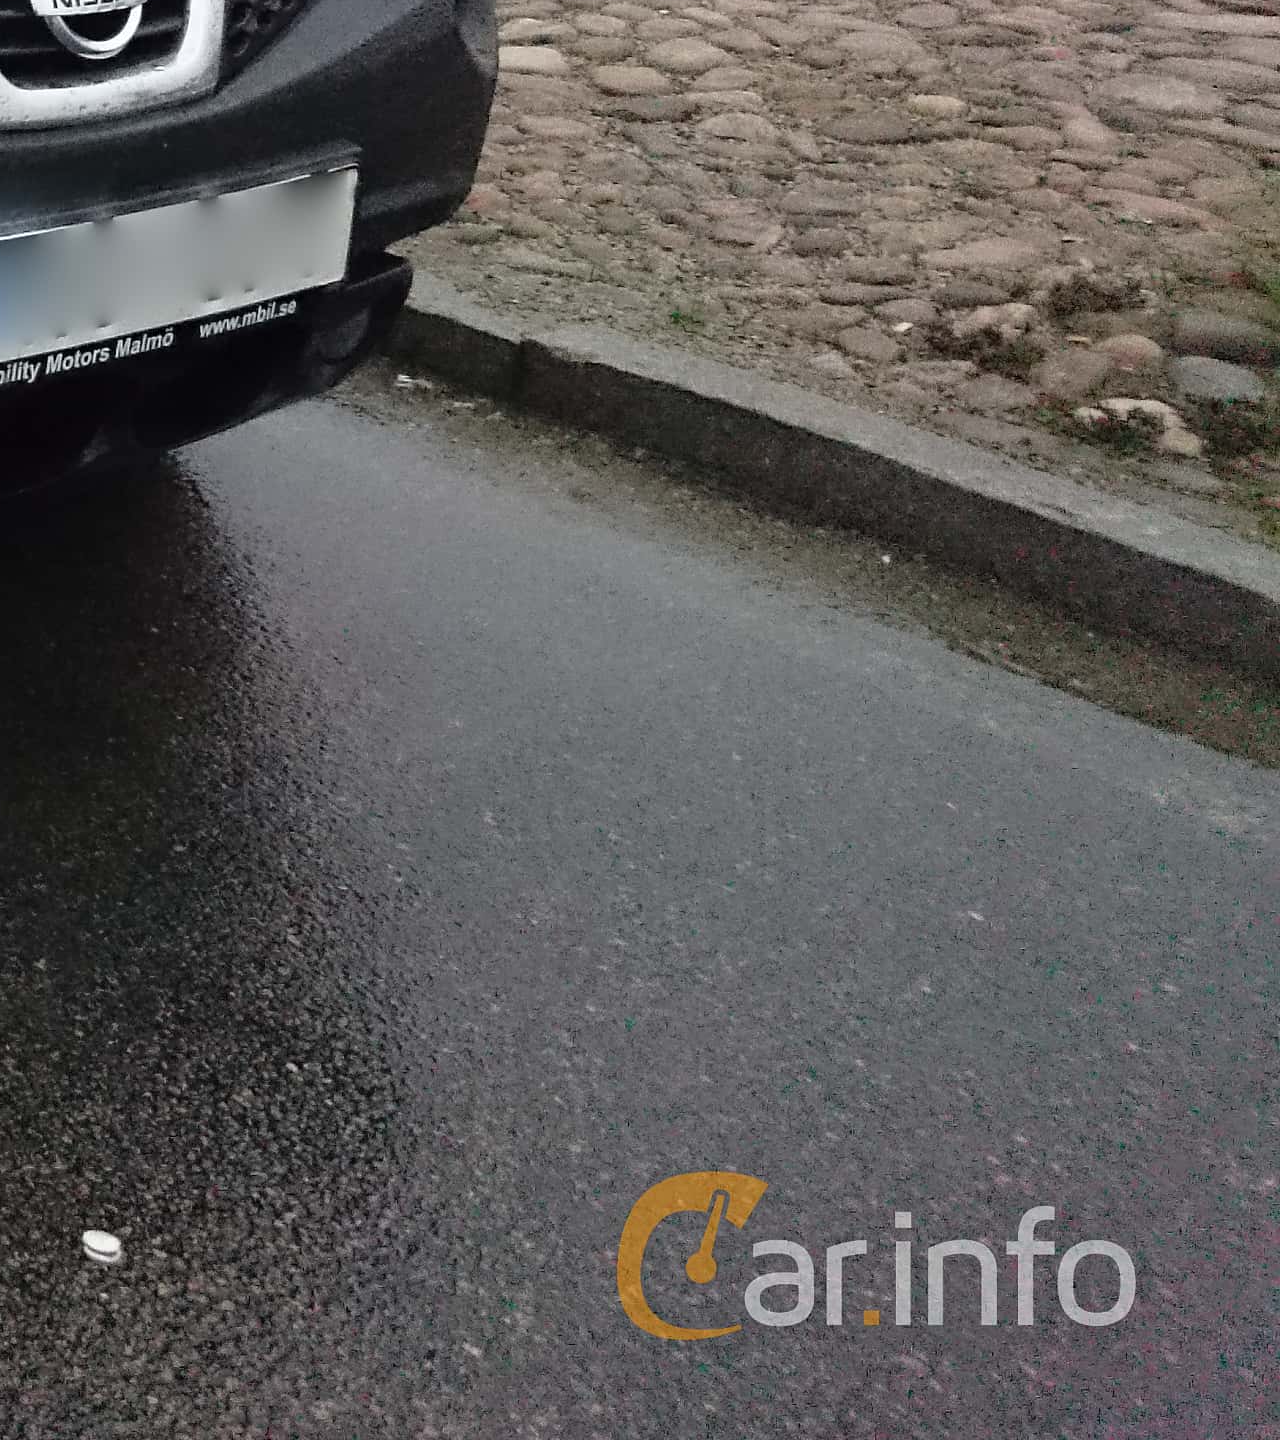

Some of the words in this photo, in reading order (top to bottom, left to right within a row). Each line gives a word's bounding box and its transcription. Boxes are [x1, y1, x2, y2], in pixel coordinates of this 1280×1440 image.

[45, 347, 110, 375] Motors
[115, 327, 175, 359] Malmö
[199, 299, 297, 338] www.mbil.se
